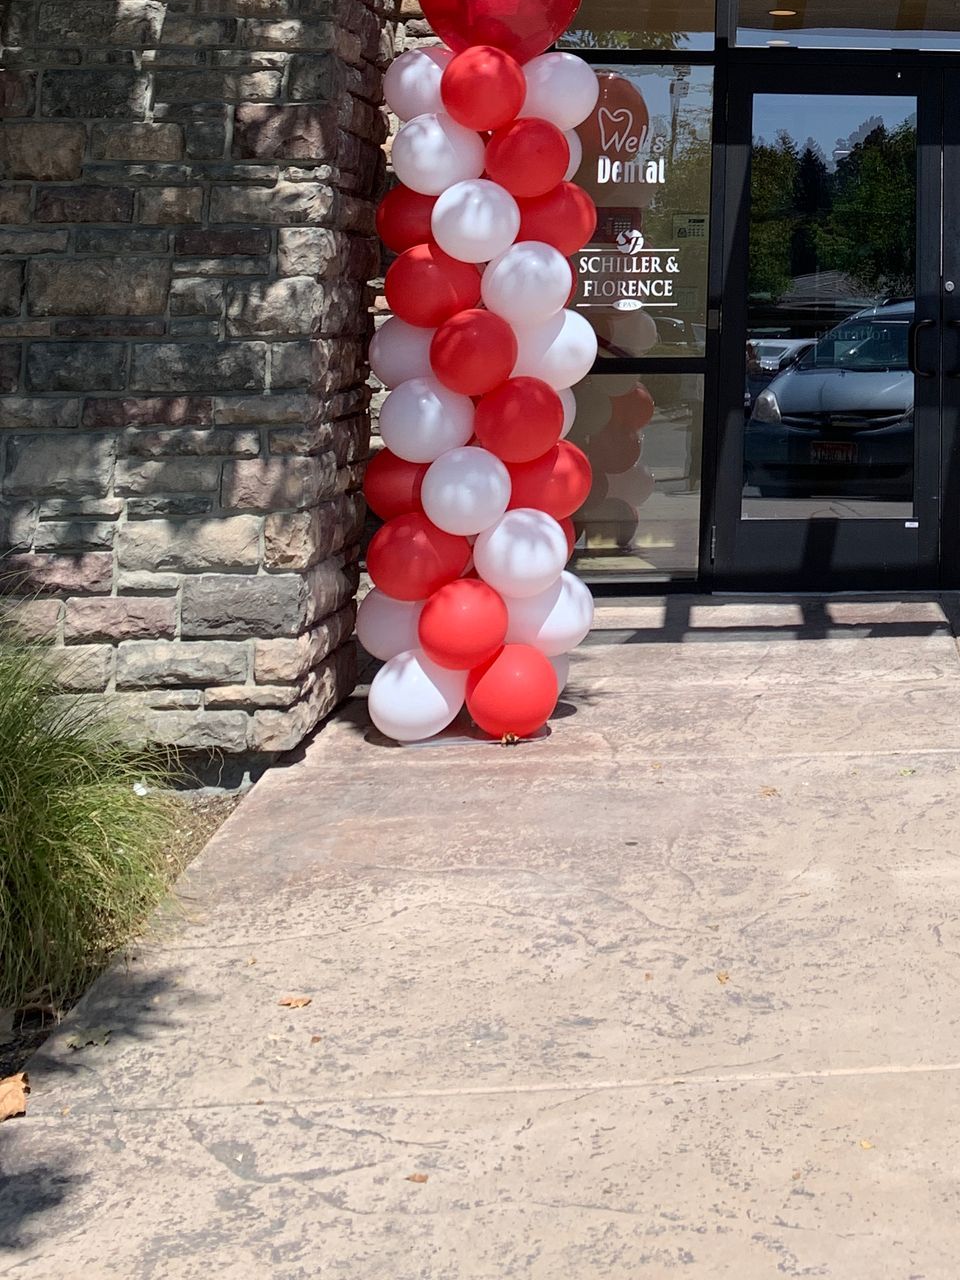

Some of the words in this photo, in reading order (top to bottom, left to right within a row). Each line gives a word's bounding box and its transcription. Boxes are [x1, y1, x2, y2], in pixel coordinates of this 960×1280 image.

[597, 155, 666, 184] Dental
[579, 256, 663, 273] SCHILLER
[665, 256, 680, 273] &
[583, 280, 673, 297] FLORENCE
